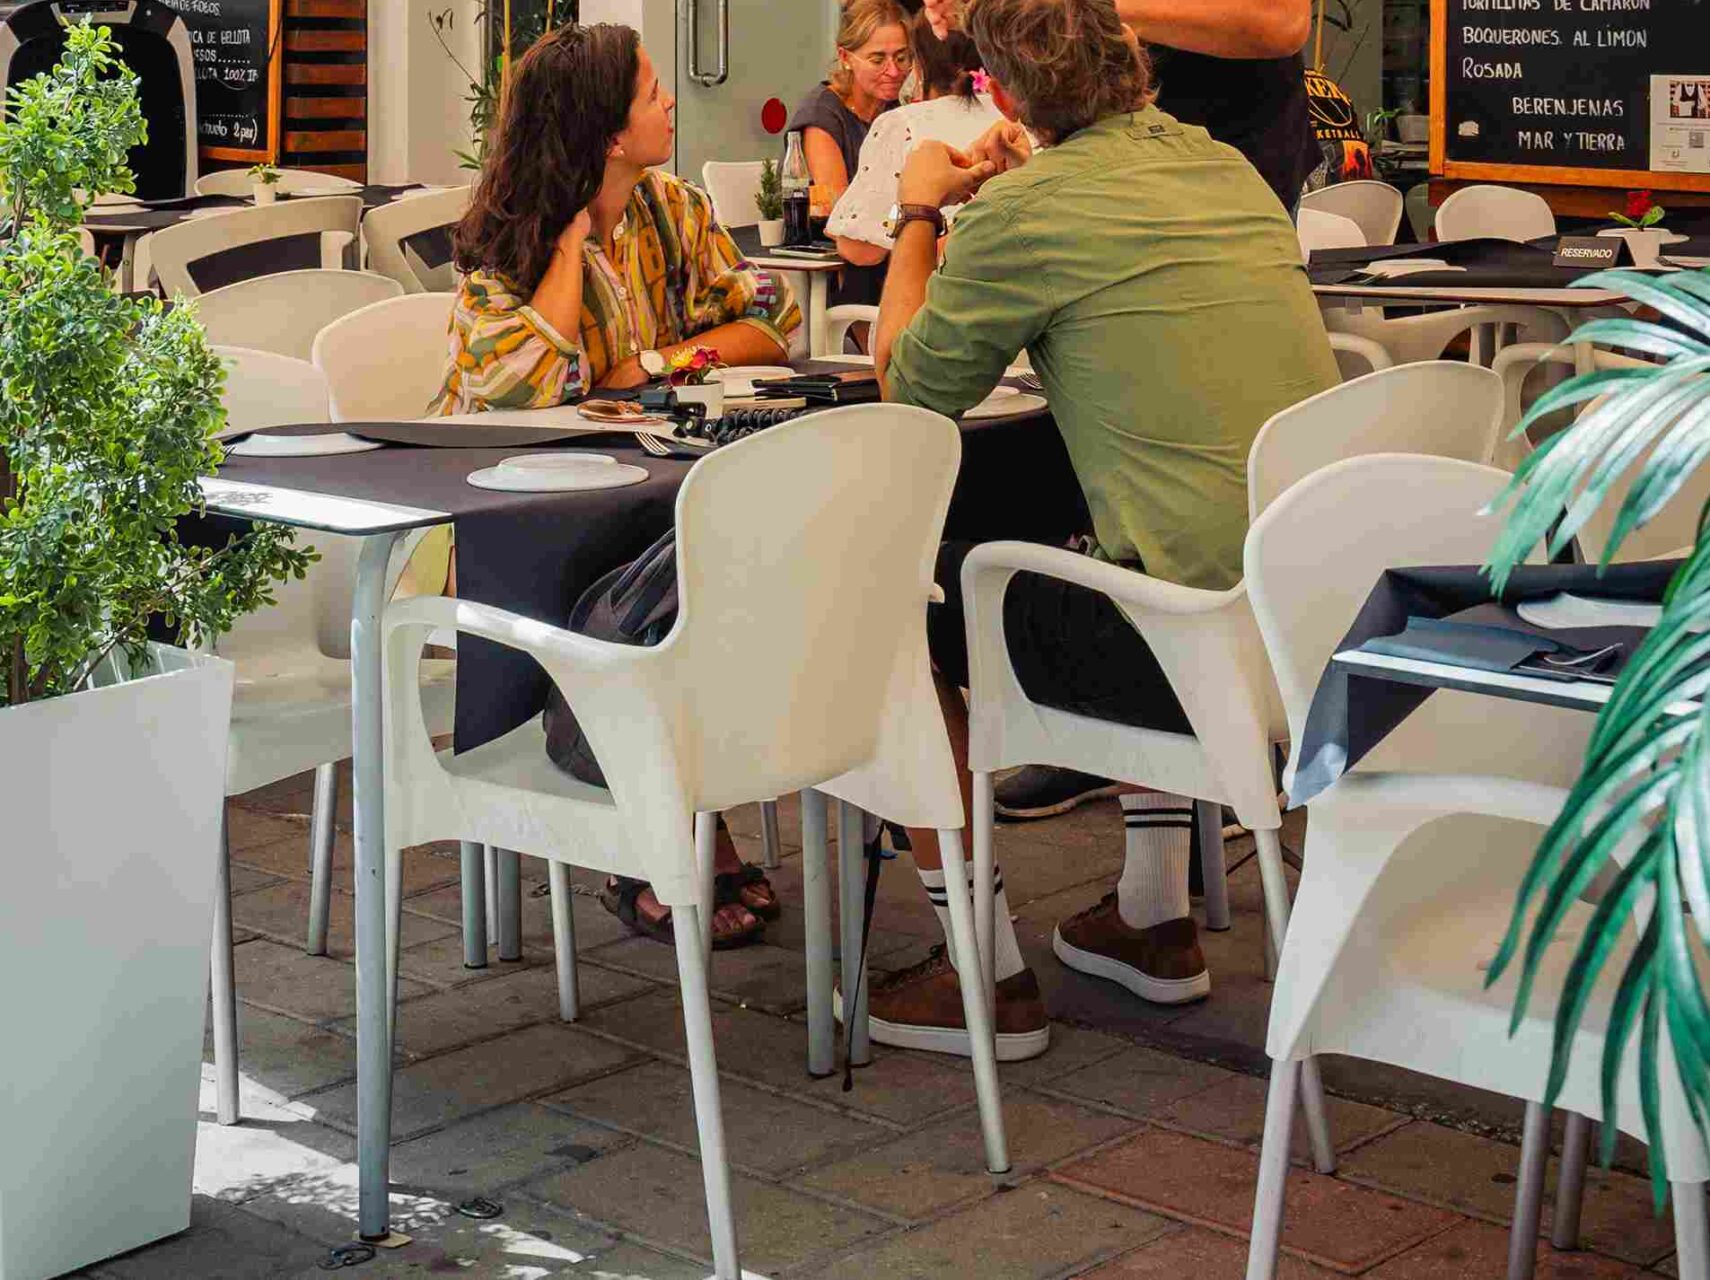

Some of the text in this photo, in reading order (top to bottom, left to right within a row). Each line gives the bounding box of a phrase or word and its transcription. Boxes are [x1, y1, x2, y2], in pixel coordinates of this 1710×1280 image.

[1573, 30, 1591, 47] AL
[1462, 57, 1523, 79] ROSADA
[1512, 97, 1624, 117] BERENJENAS
[1518, 130, 1555, 150] MAR
[1576, 131, 1625, 151] TIERRA
[1560, 247, 1613, 259] RESERVADO
